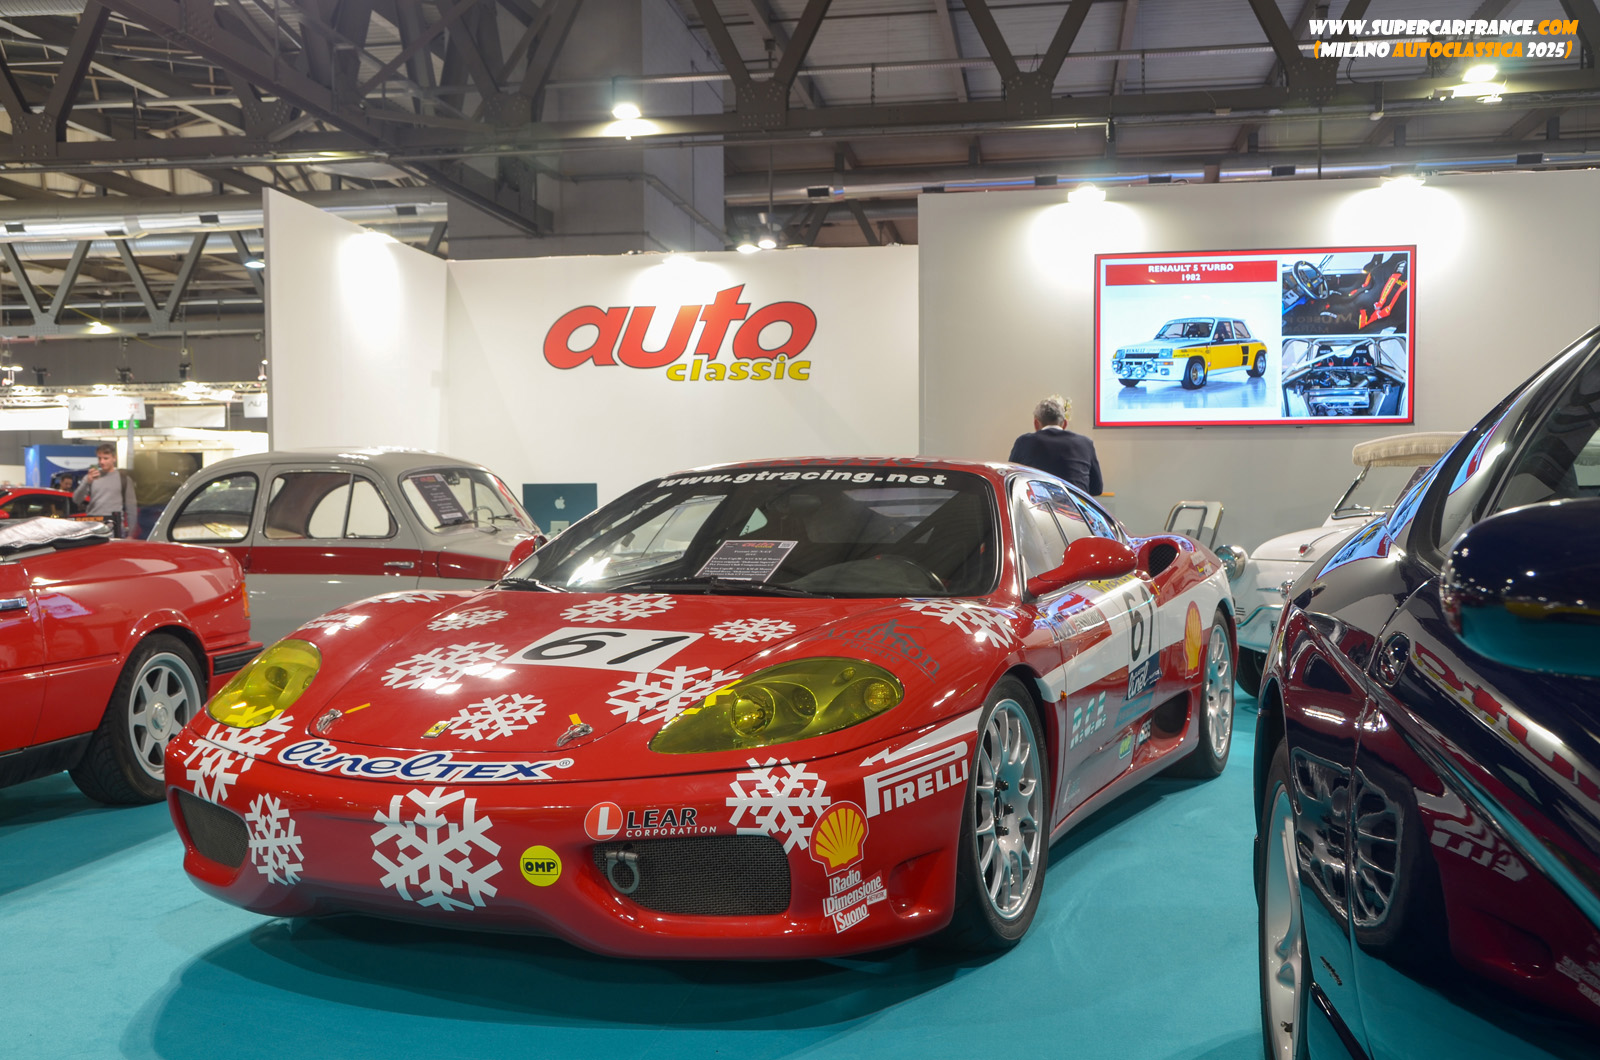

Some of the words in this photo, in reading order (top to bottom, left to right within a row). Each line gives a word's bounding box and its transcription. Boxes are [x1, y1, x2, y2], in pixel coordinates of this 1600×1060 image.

[1148, 264, 1191, 273] RENAULT
[1193, 264, 1199, 272] 5
[1200, 263, 1234, 272] TURBO
[1181, 273, 1201, 281] 1982
[543, 283, 818, 370] auto
[666, 355, 812, 381] classic
[657, 468, 948, 489] www.gtracing.net
[1122, 585, 1154, 662] 61
[522, 631, 690, 665] 61
[863, 740, 969, 819] PIRELLI
[626, 807, 698, 830] LEAR
[626, 826, 717, 838] CORPORATION
[524, 860, 556, 873] OMP
[832, 869, 861, 893] Radio
[826, 875, 882, 914] Dimensione
[836, 903, 868, 930] Suono
